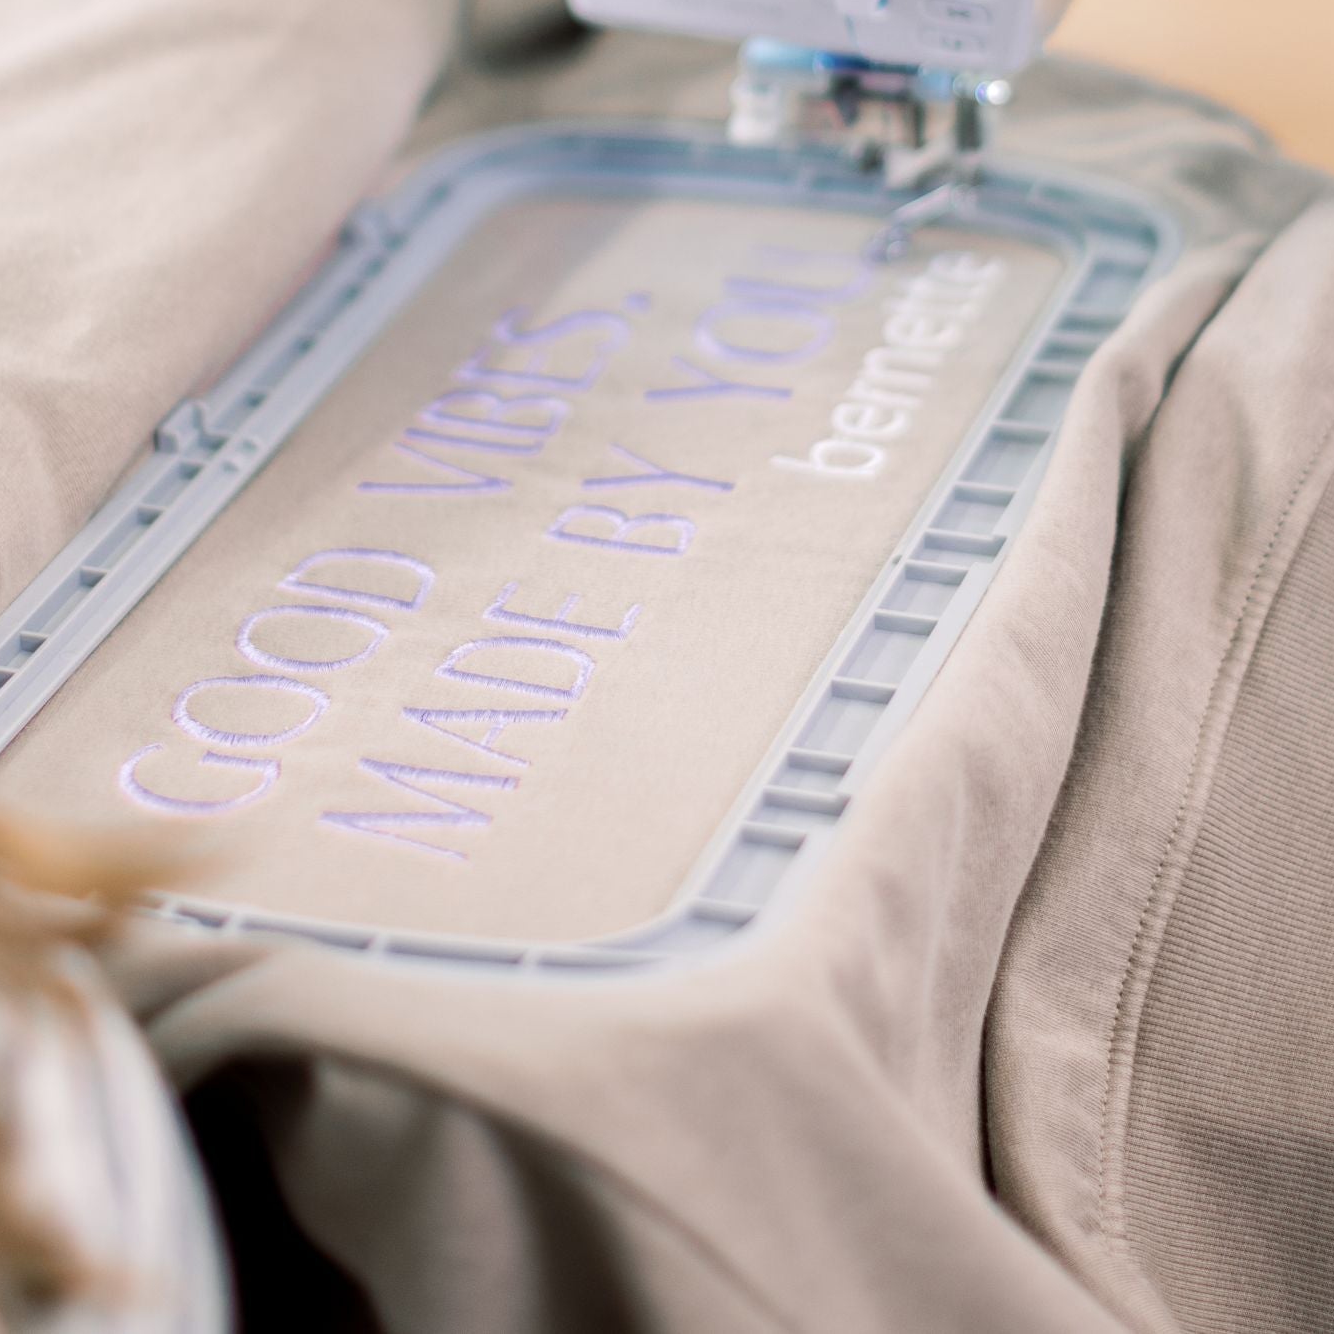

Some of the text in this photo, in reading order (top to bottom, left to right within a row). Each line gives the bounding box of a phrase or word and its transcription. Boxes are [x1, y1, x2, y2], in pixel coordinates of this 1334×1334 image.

[118, 289, 654, 816] GOOD VIBES.
[318, 581, 643, 861] MADE
[546, 443, 736, 556] BY
[643, 242, 879, 402] YOU
[769, 248, 1008, 480] bernette
